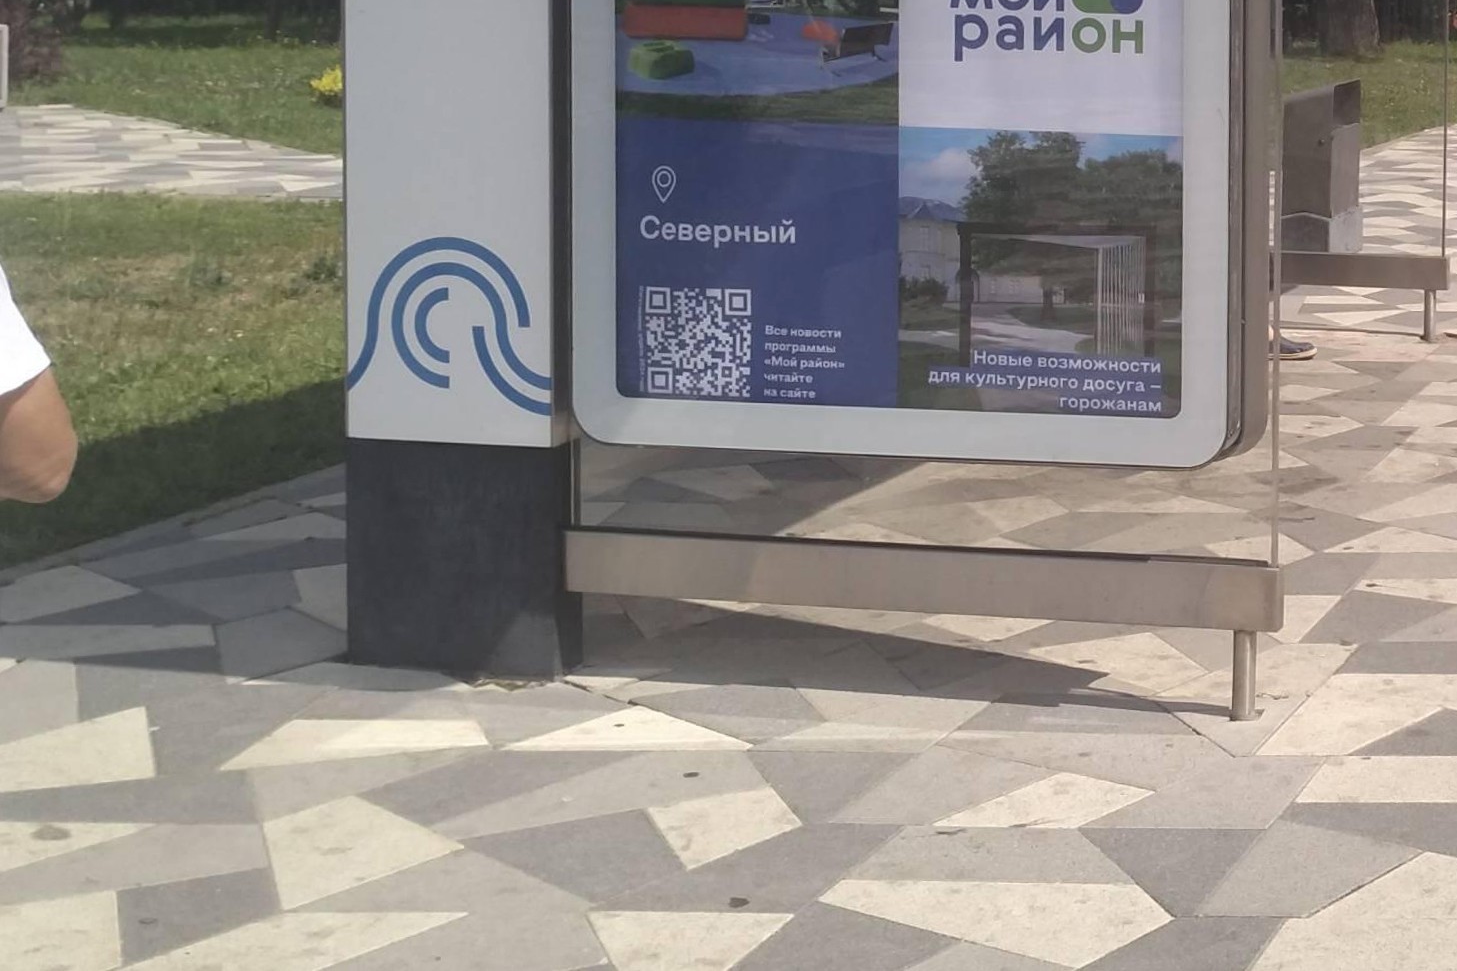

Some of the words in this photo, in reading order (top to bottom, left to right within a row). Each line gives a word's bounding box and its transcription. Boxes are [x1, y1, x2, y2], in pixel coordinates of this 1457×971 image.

[639, 215, 796, 249] Северный
[765, 325, 788, 336] Все
[790, 329, 842, 339] новости
[764, 342, 836, 354] программы
[764, 356, 798, 367] «Мой
[800, 358, 845, 370] район»
[973, 350, 1033, 367] Новые
[1038, 356, 1161, 373] возможности
[764, 372, 813, 384] читайте
[928, 370, 960, 384] для
[965, 370, 1078, 389] культурного
[1083, 378, 1145, 394] досуга
[764, 388, 778, 398] на
[780, 388, 816, 399] сайте
[1059, 395, 1161, 412] горожанам
